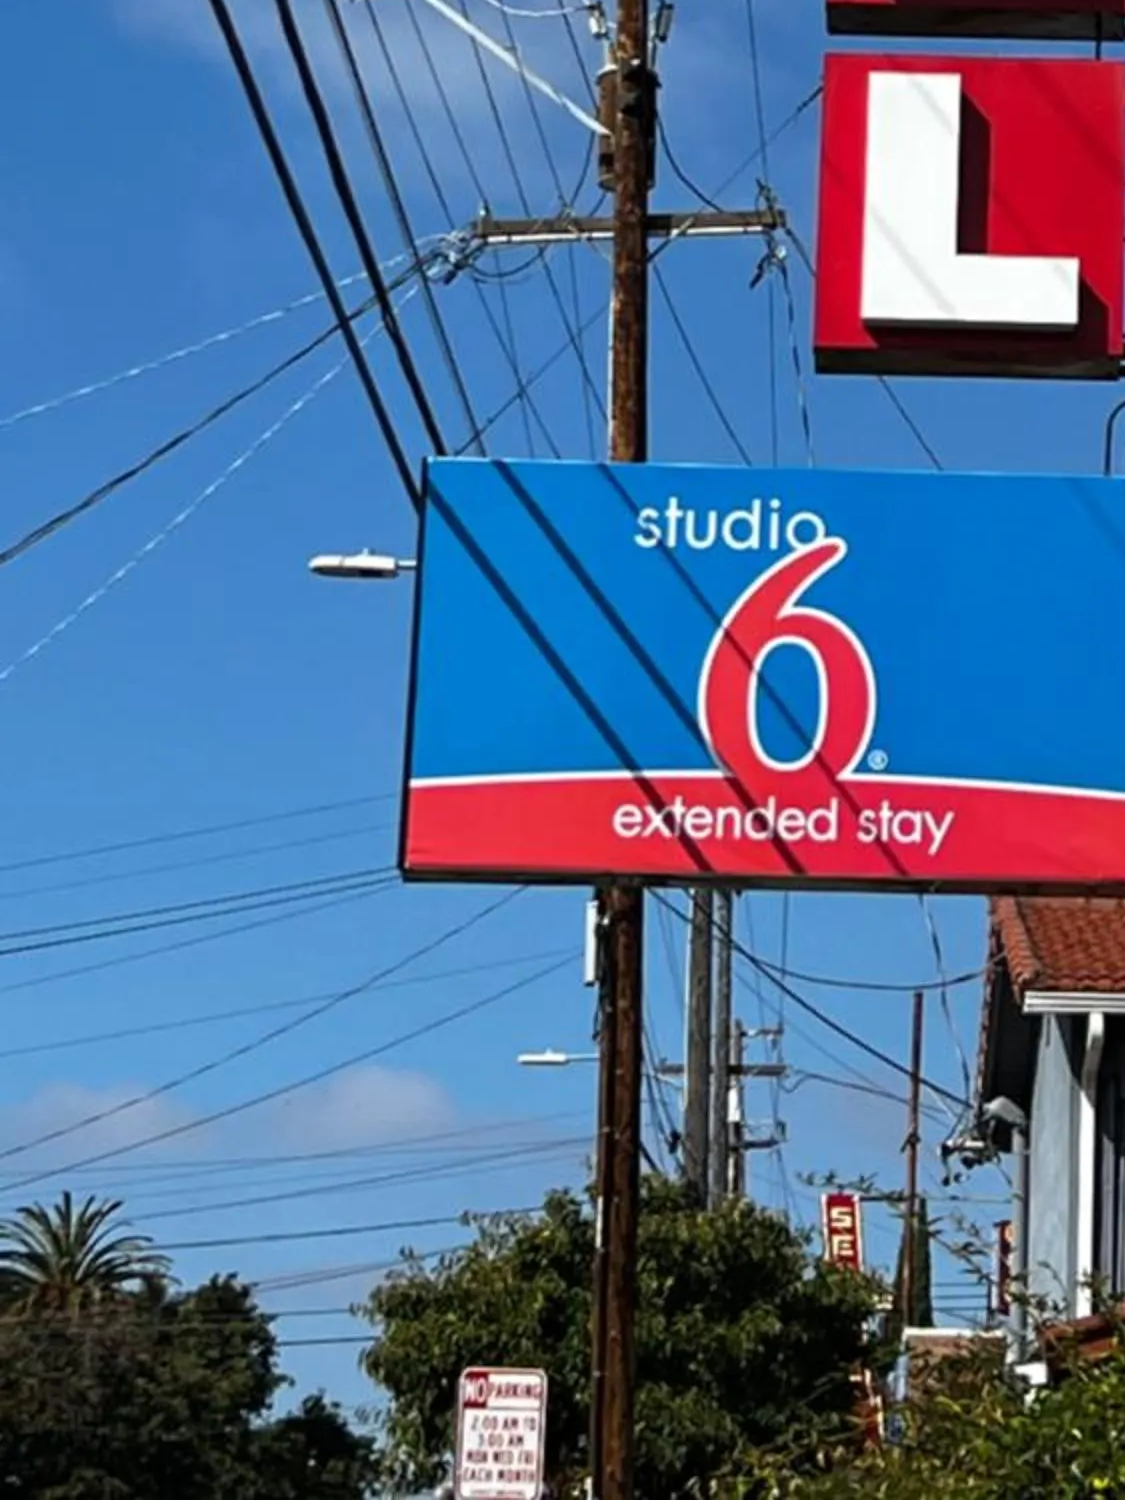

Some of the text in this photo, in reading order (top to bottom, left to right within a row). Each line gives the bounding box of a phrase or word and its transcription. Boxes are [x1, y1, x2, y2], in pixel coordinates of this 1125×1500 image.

[635, 496, 827, 550] studio
[697, 536, 876, 782] 6
[612, 795, 954, 855] extended stay
[463, 1377, 543, 1403] NO PARKING
[502, 1415, 519, 1431] AM
[507, 1434, 525, 1448] AM
